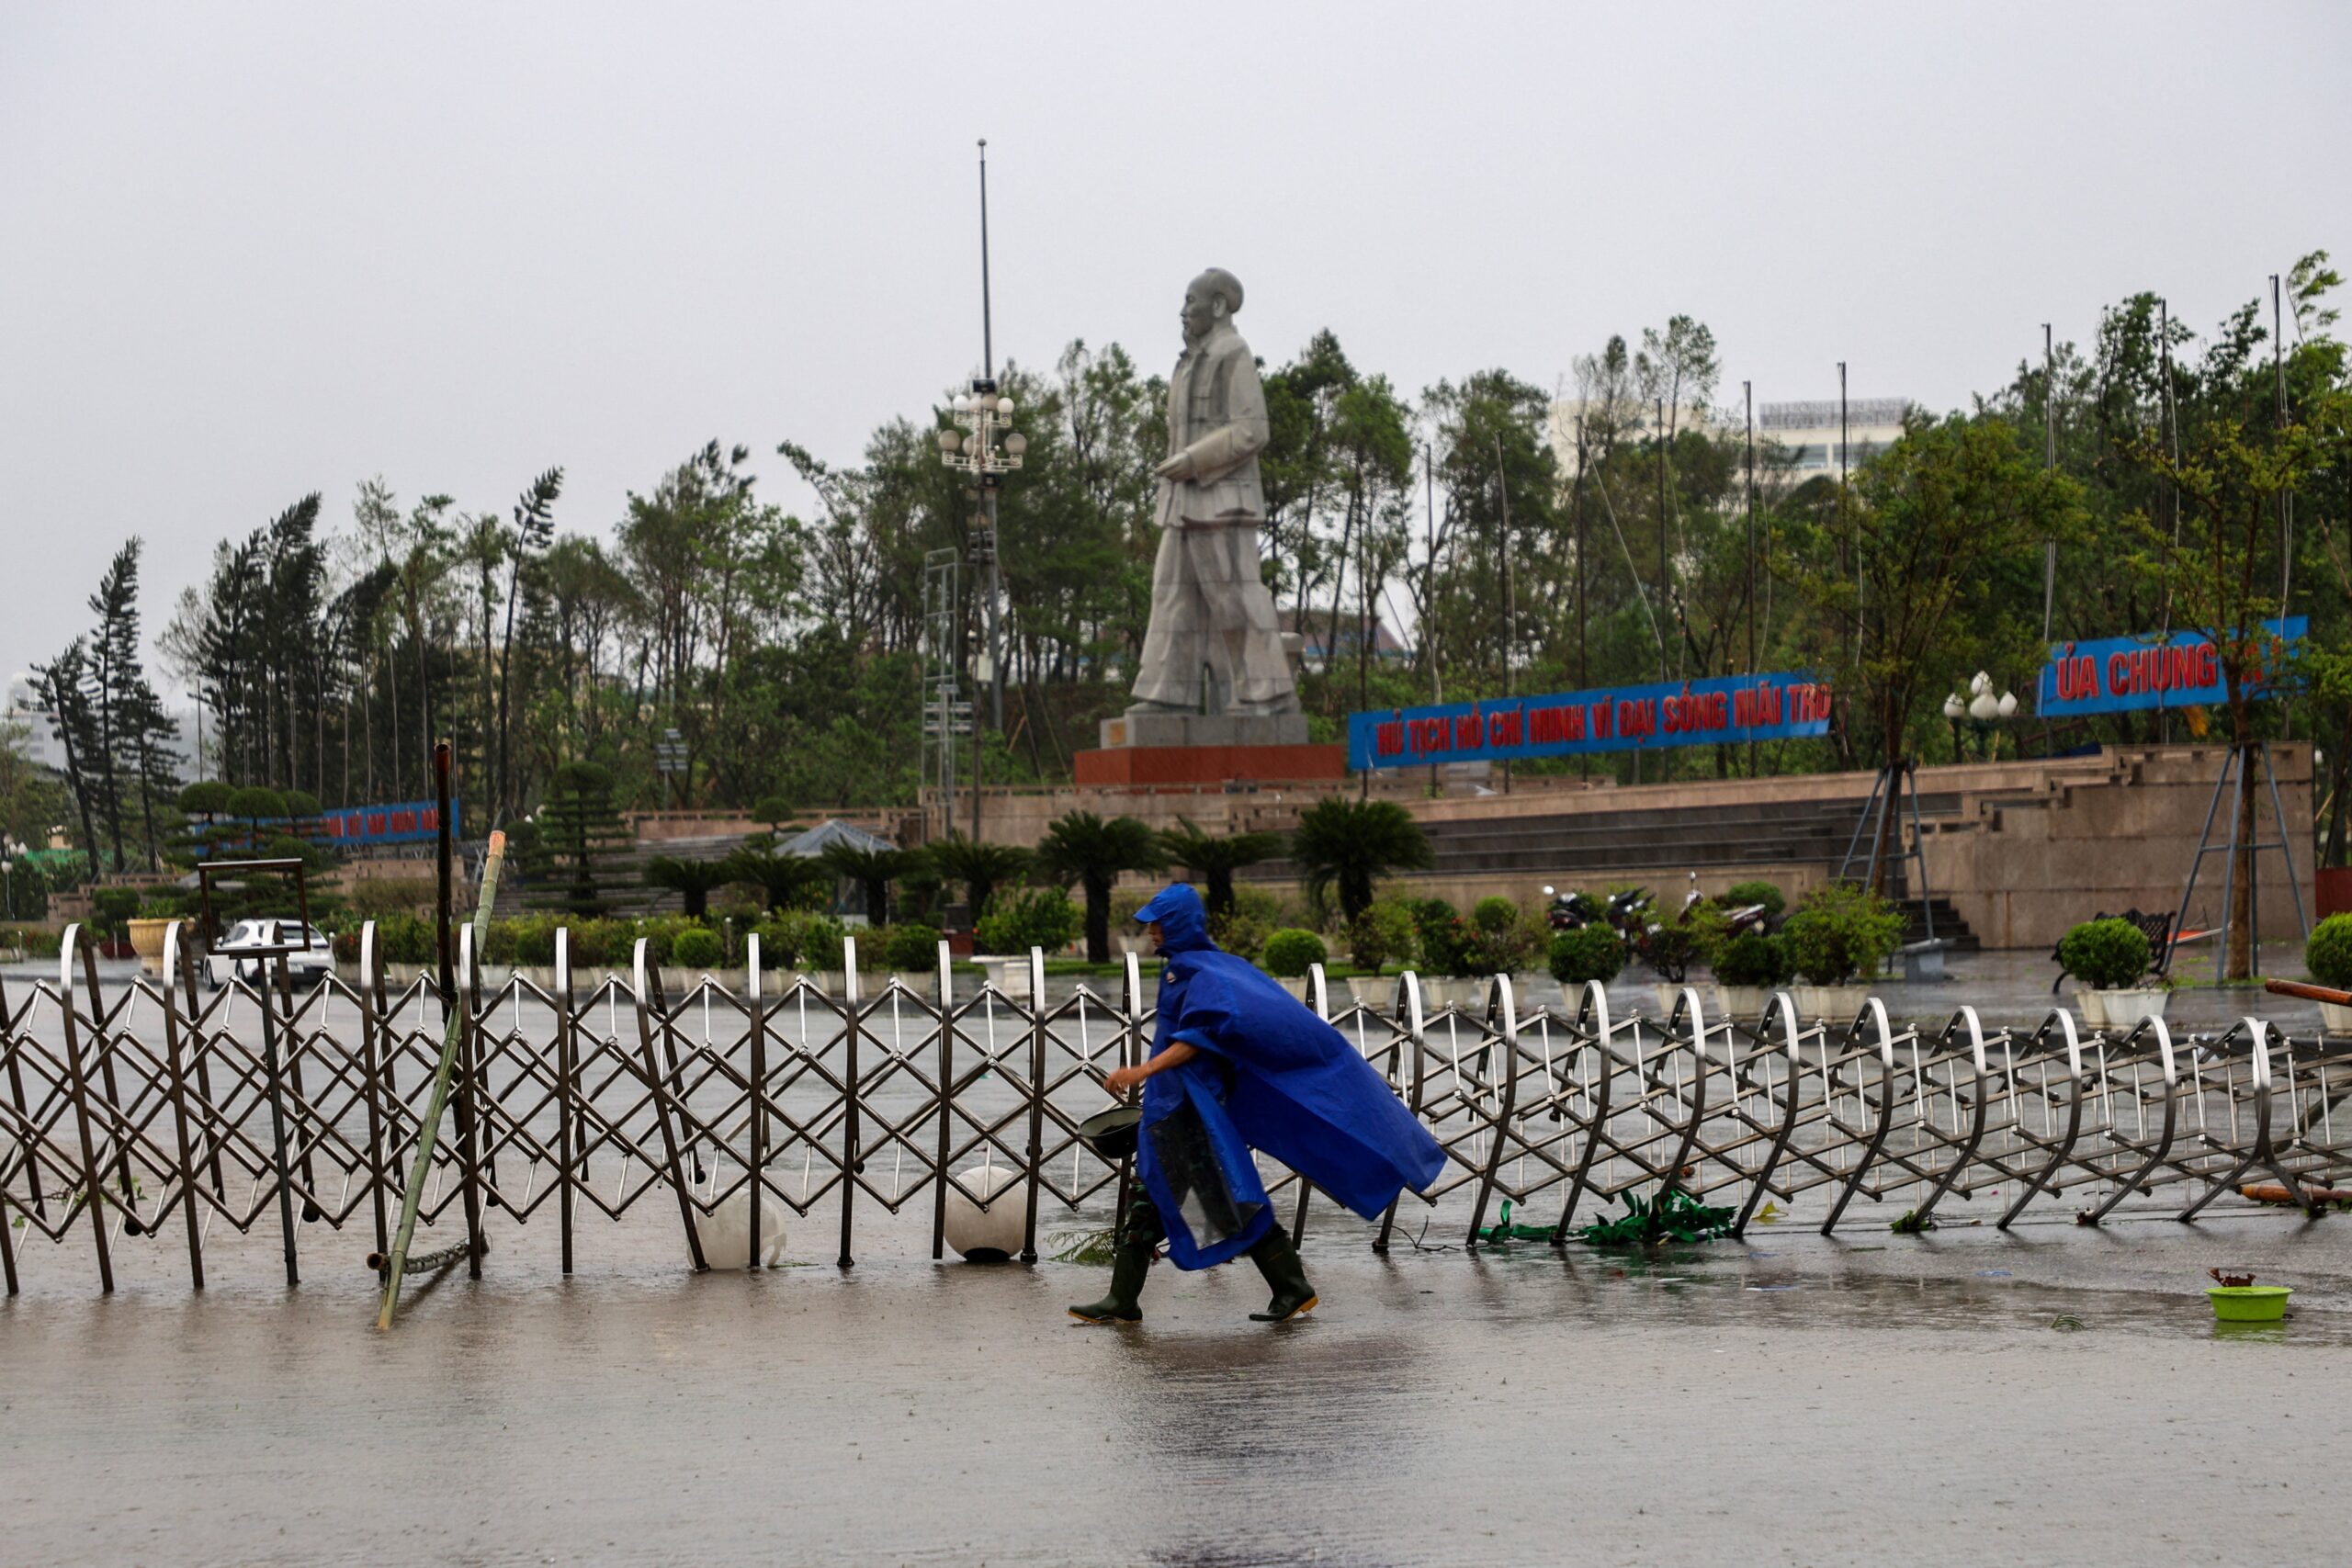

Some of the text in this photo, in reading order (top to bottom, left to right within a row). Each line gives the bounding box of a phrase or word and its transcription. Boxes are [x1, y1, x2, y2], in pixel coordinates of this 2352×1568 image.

[1408, 716, 1451, 759] TỊCH
[1488, 702, 1525, 747] CHÍ
[1529, 704, 1585, 744] MINH
[1618, 697, 1656, 744] ĐẠI
[1734, 680, 1782, 728] MÃI
